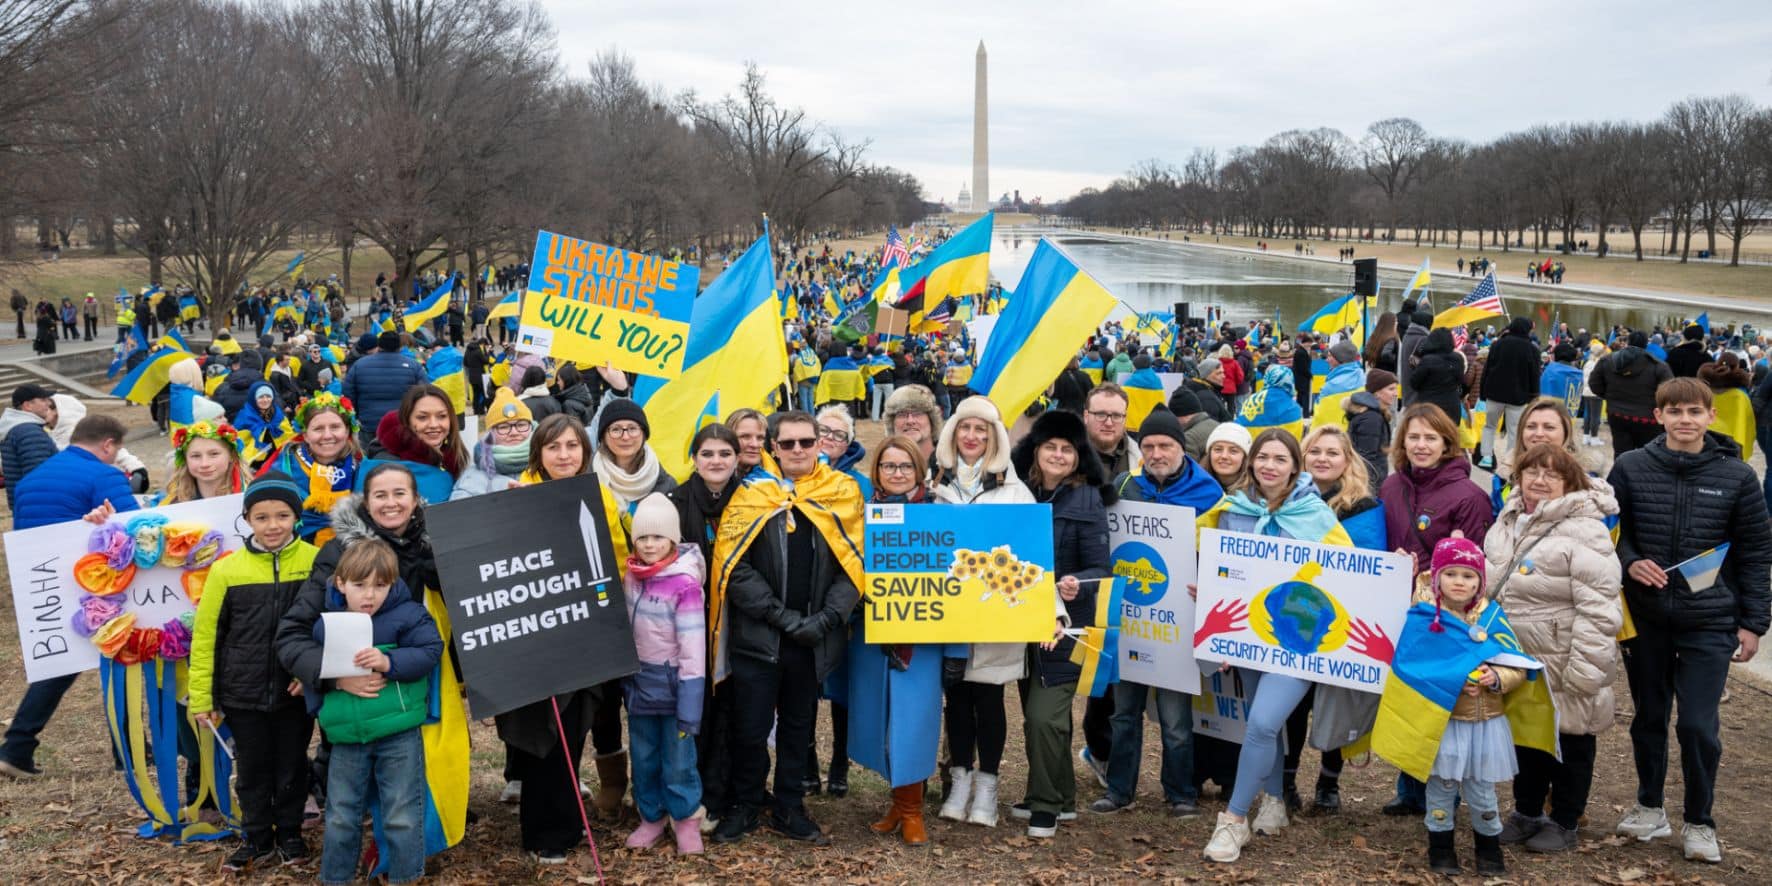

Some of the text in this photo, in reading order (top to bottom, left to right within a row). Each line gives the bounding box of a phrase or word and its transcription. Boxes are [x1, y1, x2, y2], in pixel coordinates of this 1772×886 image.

[547, 235, 680, 291] UKRAINE
[540, 294, 683, 370] WILL YOU?
[872, 531, 955, 548] HELPING
[1108, 512, 1173, 539] 3 YEARS.
[1220, 535, 1279, 561] FREEDOM
[1284, 545, 1311, 565] FOR
[478, 549, 555, 582] PEACE
[459, 570, 582, 617] THROUGH
[872, 577, 962, 597] SAVING
[461, 601, 590, 651] STRENGTH
[872, 601, 945, 622] LIVES
[1120, 603, 1176, 625] TED FOR
[1120, 616, 1180, 645] RAINE!
[1209, 637, 1381, 685] SECURITY FOR THE WORLD!
[1216, 695, 1239, 721] WE
